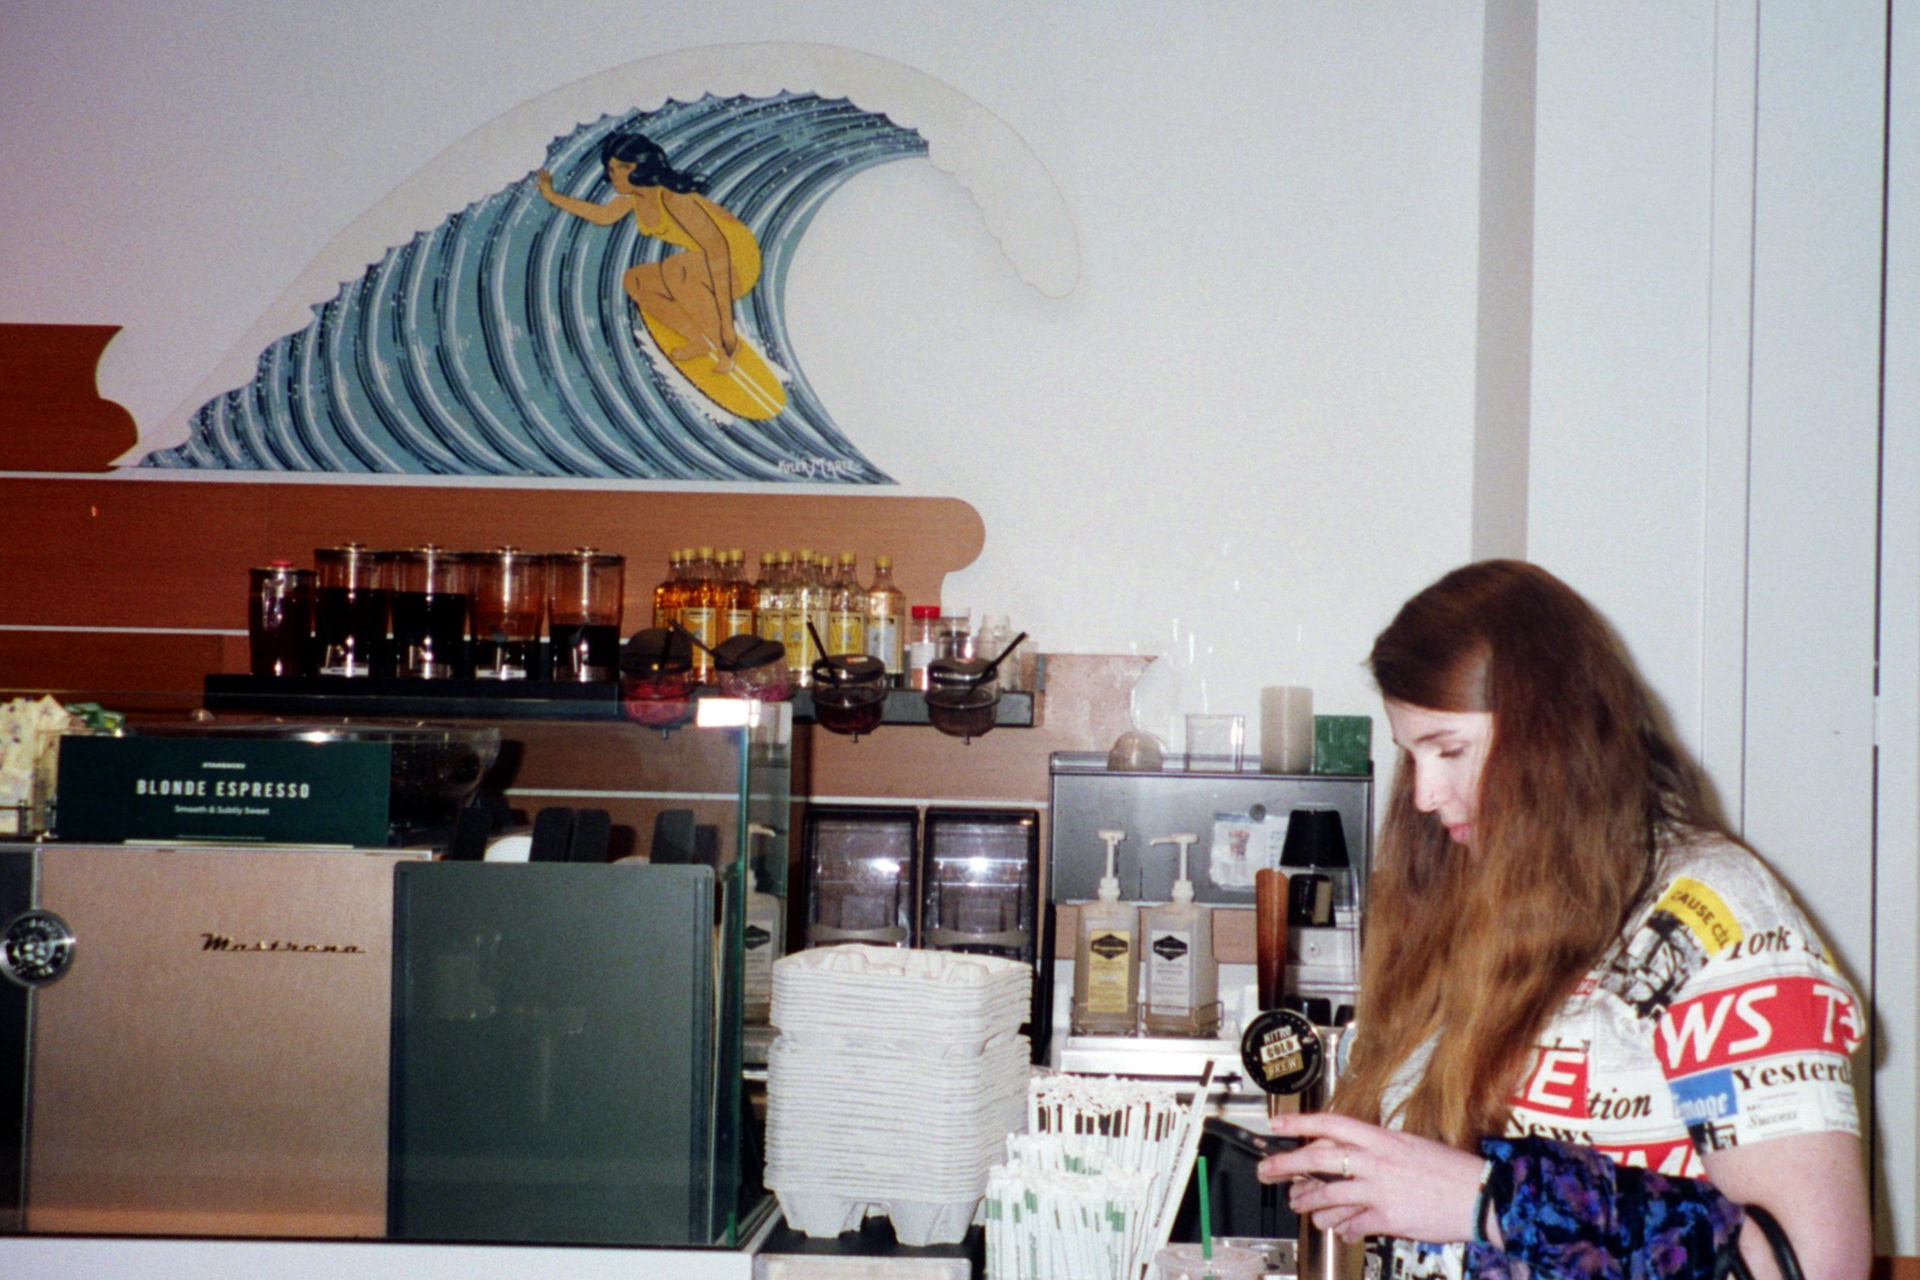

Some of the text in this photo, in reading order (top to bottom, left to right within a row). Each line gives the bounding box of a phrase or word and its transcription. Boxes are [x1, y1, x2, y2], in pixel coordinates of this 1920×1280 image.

[136, 779, 311, 799] BLONDE ESPRESSO
[174, 804, 207, 814] Smooth
[244, 805, 270, 815] Sweet
[1266, 1039, 1294, 1059] COLD
[1269, 1057, 1298, 1077] BREW
